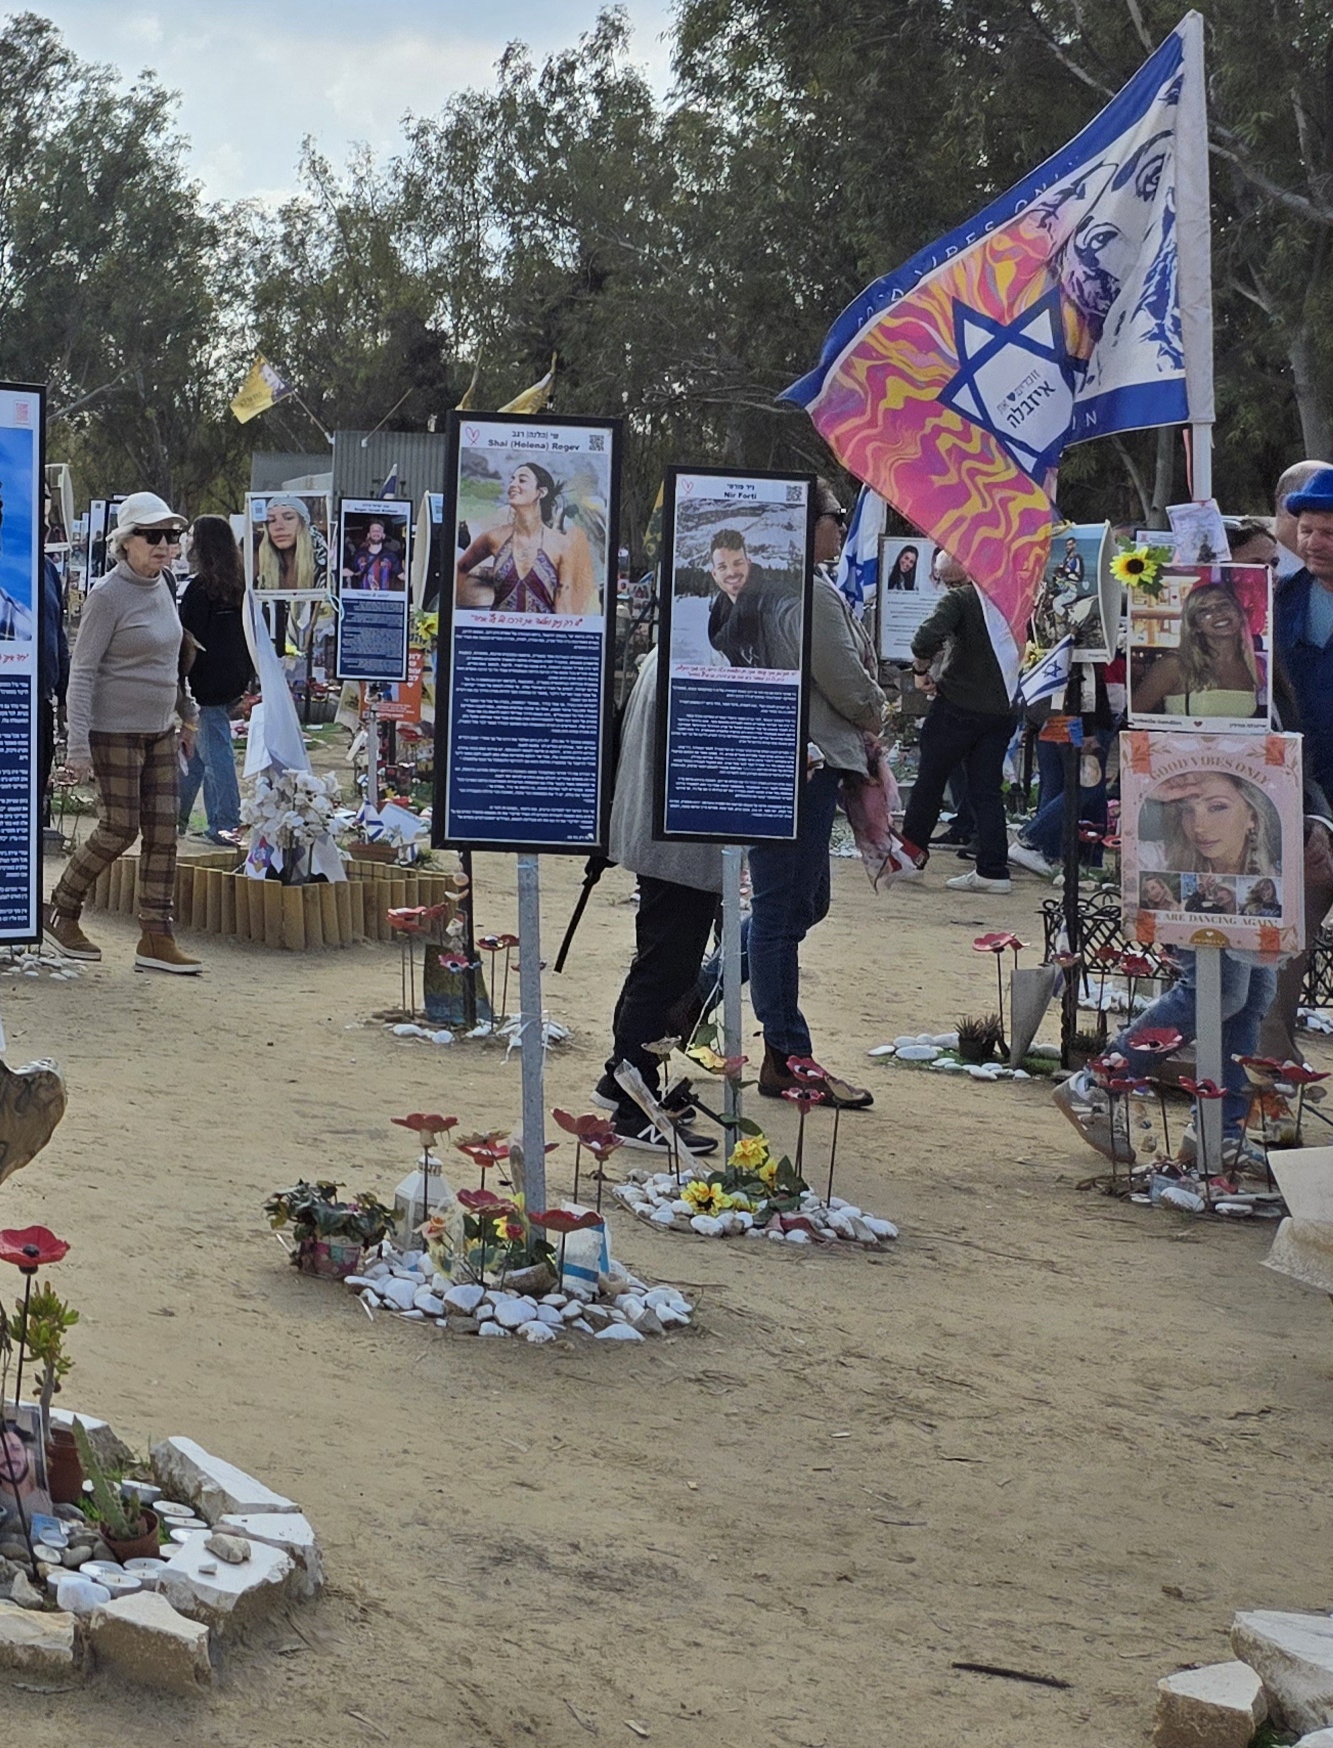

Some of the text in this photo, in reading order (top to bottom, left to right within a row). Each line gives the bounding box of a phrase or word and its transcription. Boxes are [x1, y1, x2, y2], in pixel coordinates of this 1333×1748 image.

[1006, 380, 1057, 429] איזבלה
[738, 492, 757, 500] Forti
[1151, 756, 1272, 784] GOOD VIBES ONLY
[1165, 913, 1186, 921] ARE
[1189, 914, 1237, 925] DANCING
